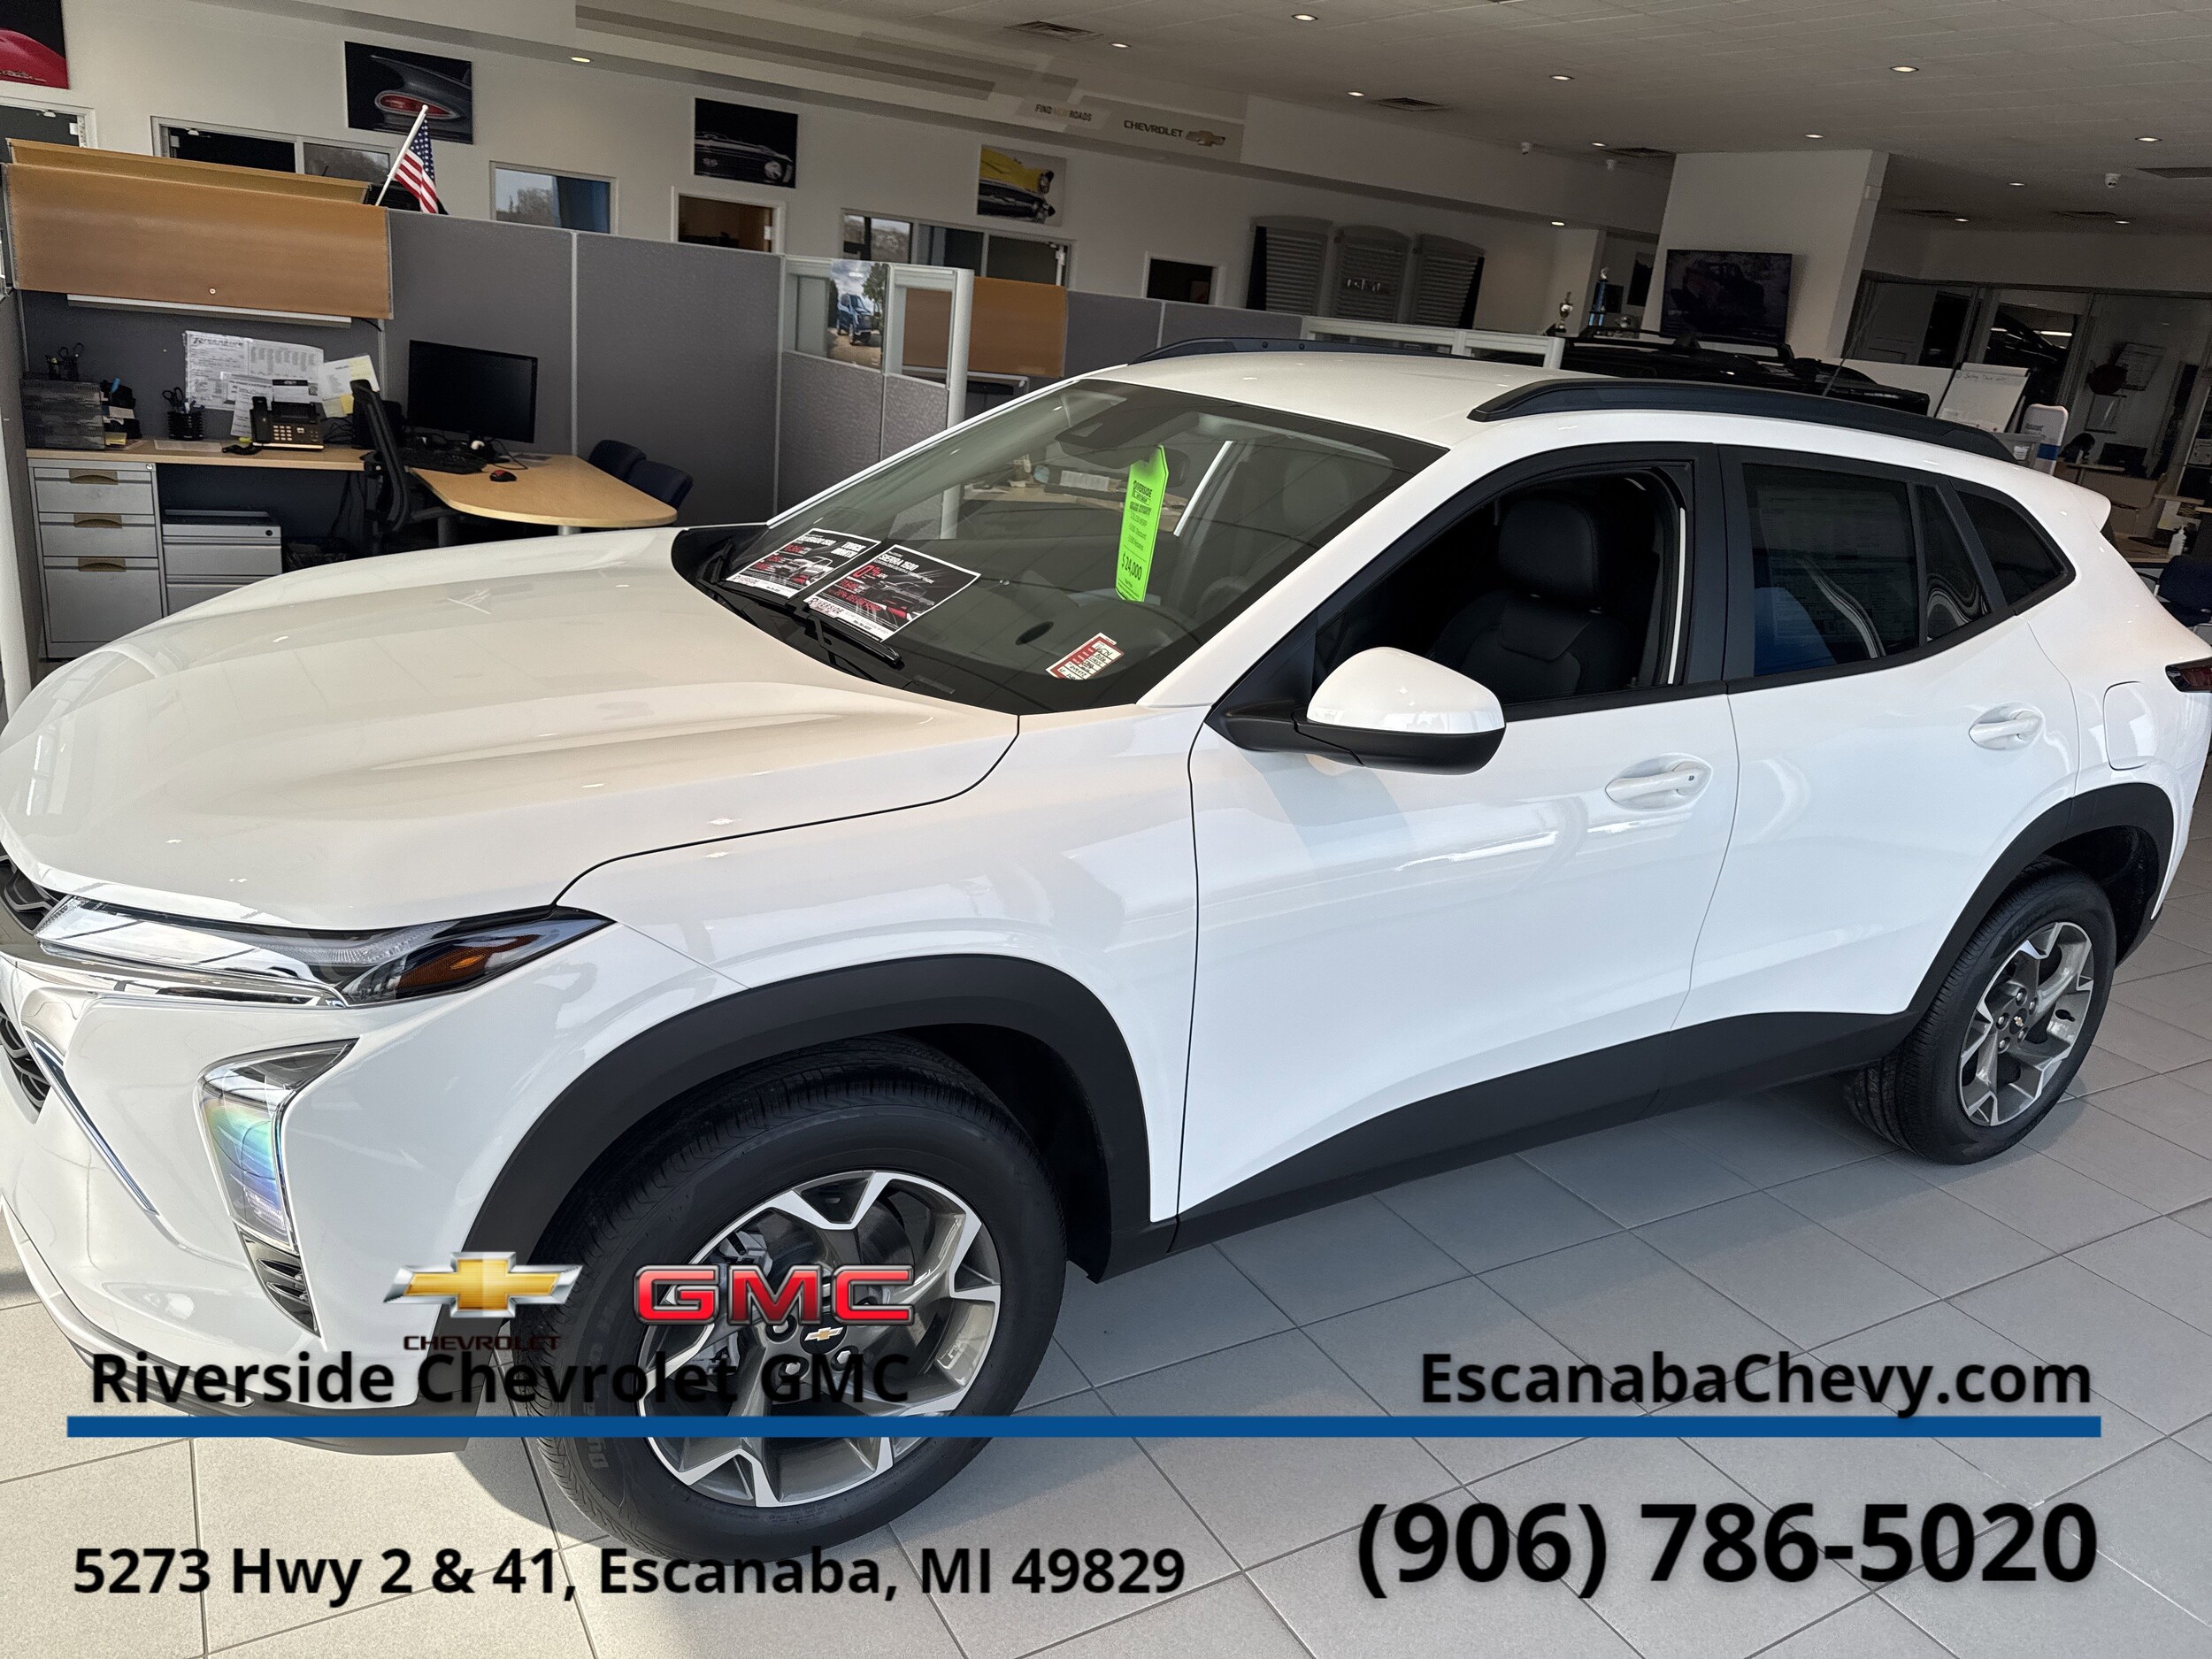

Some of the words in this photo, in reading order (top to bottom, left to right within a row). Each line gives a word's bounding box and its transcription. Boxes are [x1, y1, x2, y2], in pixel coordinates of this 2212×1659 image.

[1123, 119, 1184, 138] CHEVROLET
[879, 554, 904, 566] SIERRA
[900, 561, 919, 572] 1500
